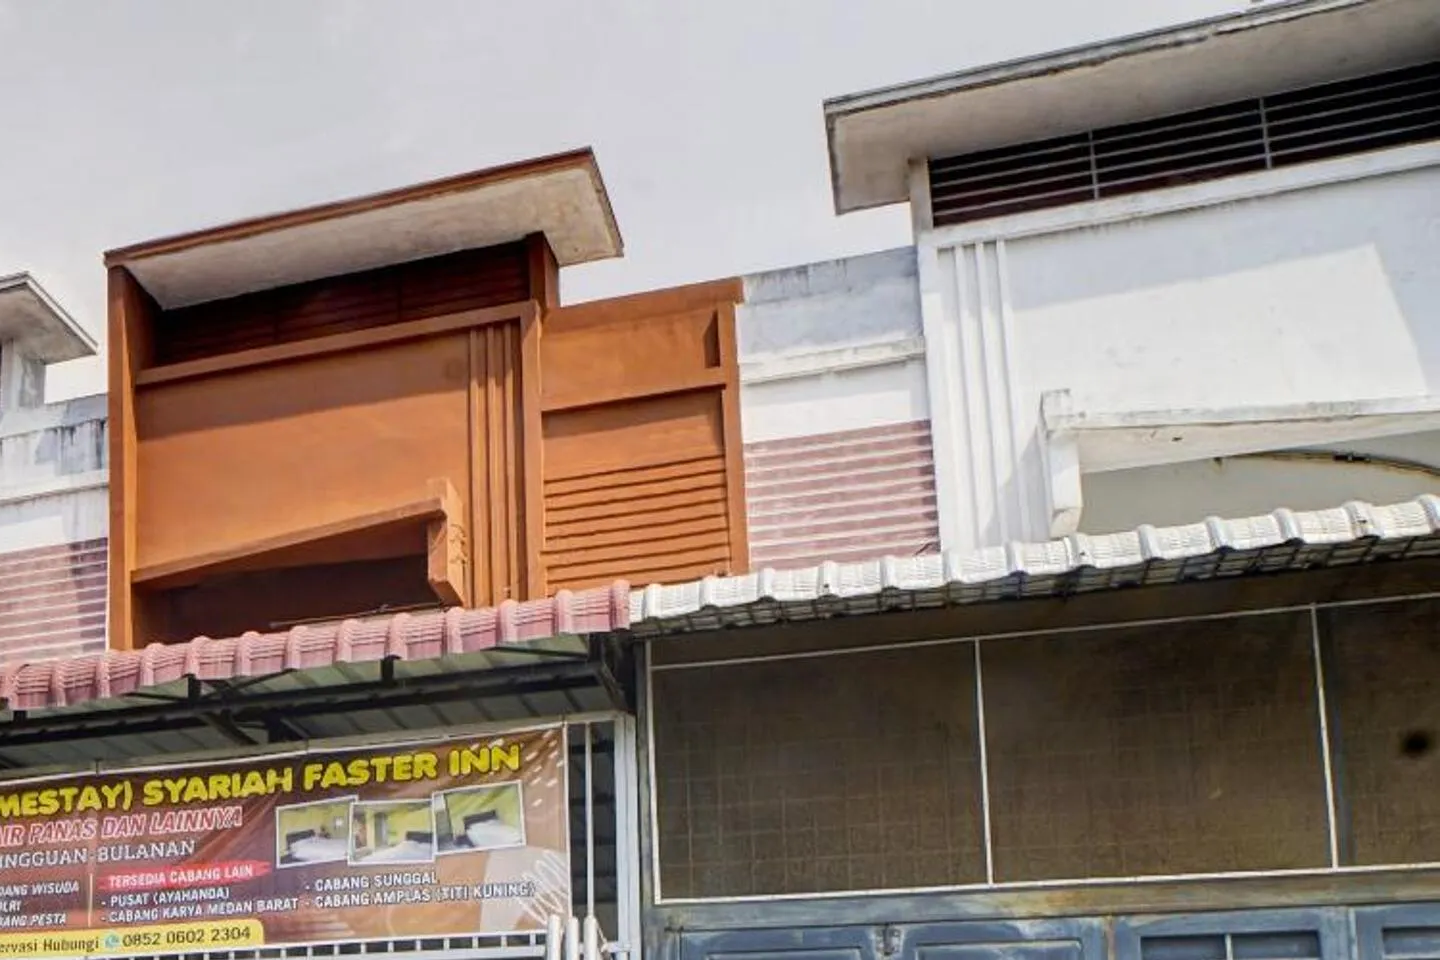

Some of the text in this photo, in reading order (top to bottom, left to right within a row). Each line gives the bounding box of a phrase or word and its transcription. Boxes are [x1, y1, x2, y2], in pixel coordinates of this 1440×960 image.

[143, 767, 293, 806] SYARIAH
[303, 752, 438, 791] FASTER
[448, 743, 520, 777] INN
[29, 817, 98, 844] PANAS
[101, 814, 147, 839] DAN
[149, 805, 243, 836] LAINNYA
[97, 840, 196, 862] BULANAN
[31, 880, 80, 894] WISUDA
[109, 864, 253, 888] TERSEDIA CABANG LAIN
[315, 871, 437, 892] CABANG SUNGGAL
[111, 887, 230, 907] PUSAT (AYAHANDA)
[315, 892, 369, 908] CABANG
[374, 887, 431, 904] AMPLAS
[30, 913, 67, 926] PESTA
[109, 897, 298, 923] CABANG KARYA MEDAN BARAT
[42, 936, 99, 952] Hubungi
[122, 932, 160, 947] 0852
[166, 930, 205, 944] 0602
[211, 926, 251, 941] 2304
